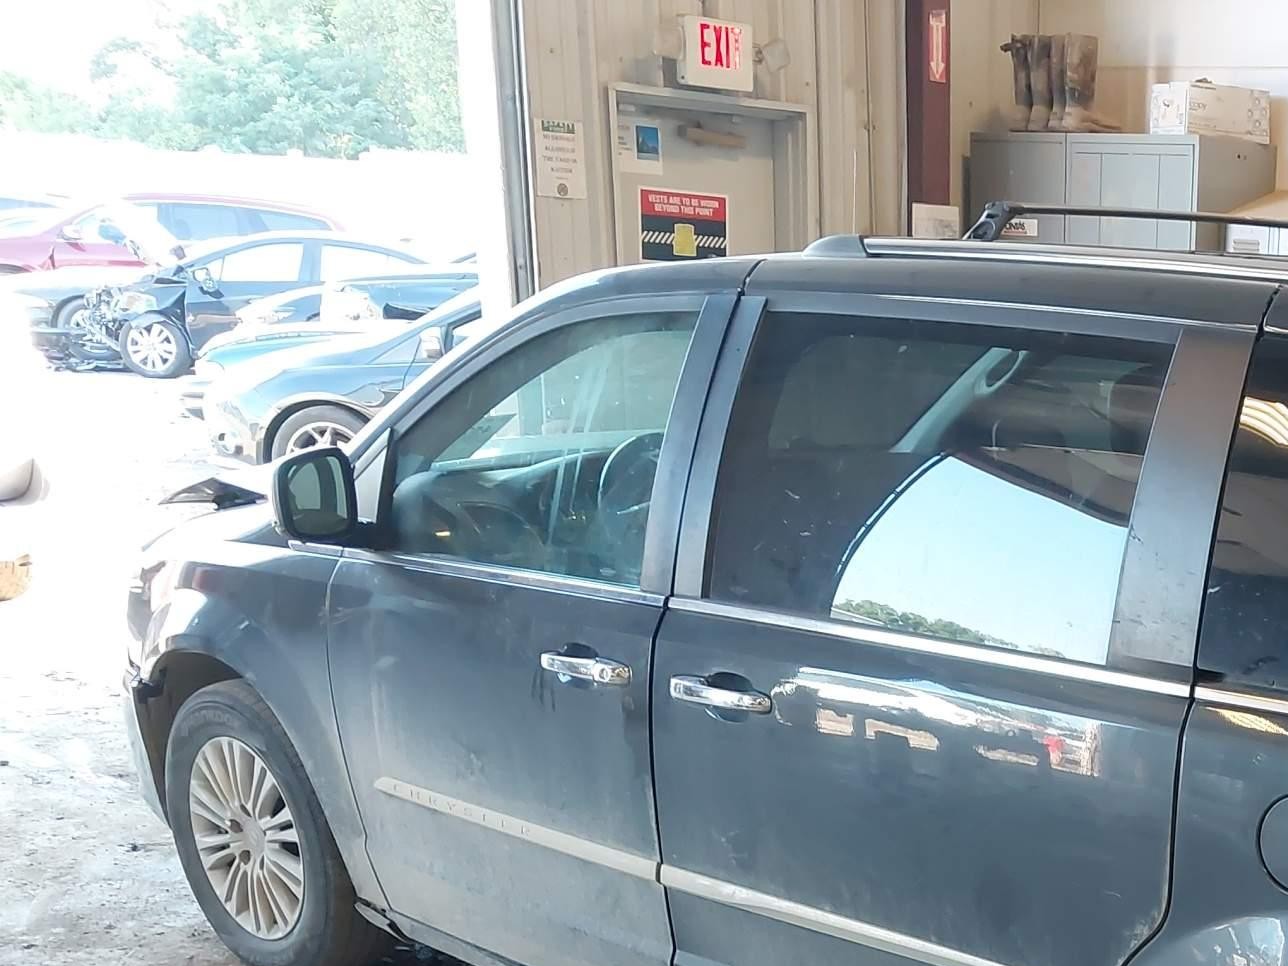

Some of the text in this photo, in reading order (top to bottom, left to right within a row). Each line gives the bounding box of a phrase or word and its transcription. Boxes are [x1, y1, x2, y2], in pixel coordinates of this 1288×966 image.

[699, 22, 743, 70] EXIT
[648, 193, 668, 204] VESTS
[669, 196, 681, 205] ARE
[682, 197, 691, 206] TO
[691, 198, 700, 207] BE
[654, 203, 713, 216] BEYOND THIS POINT
[393, 782, 531, 837] CHRYSLER
